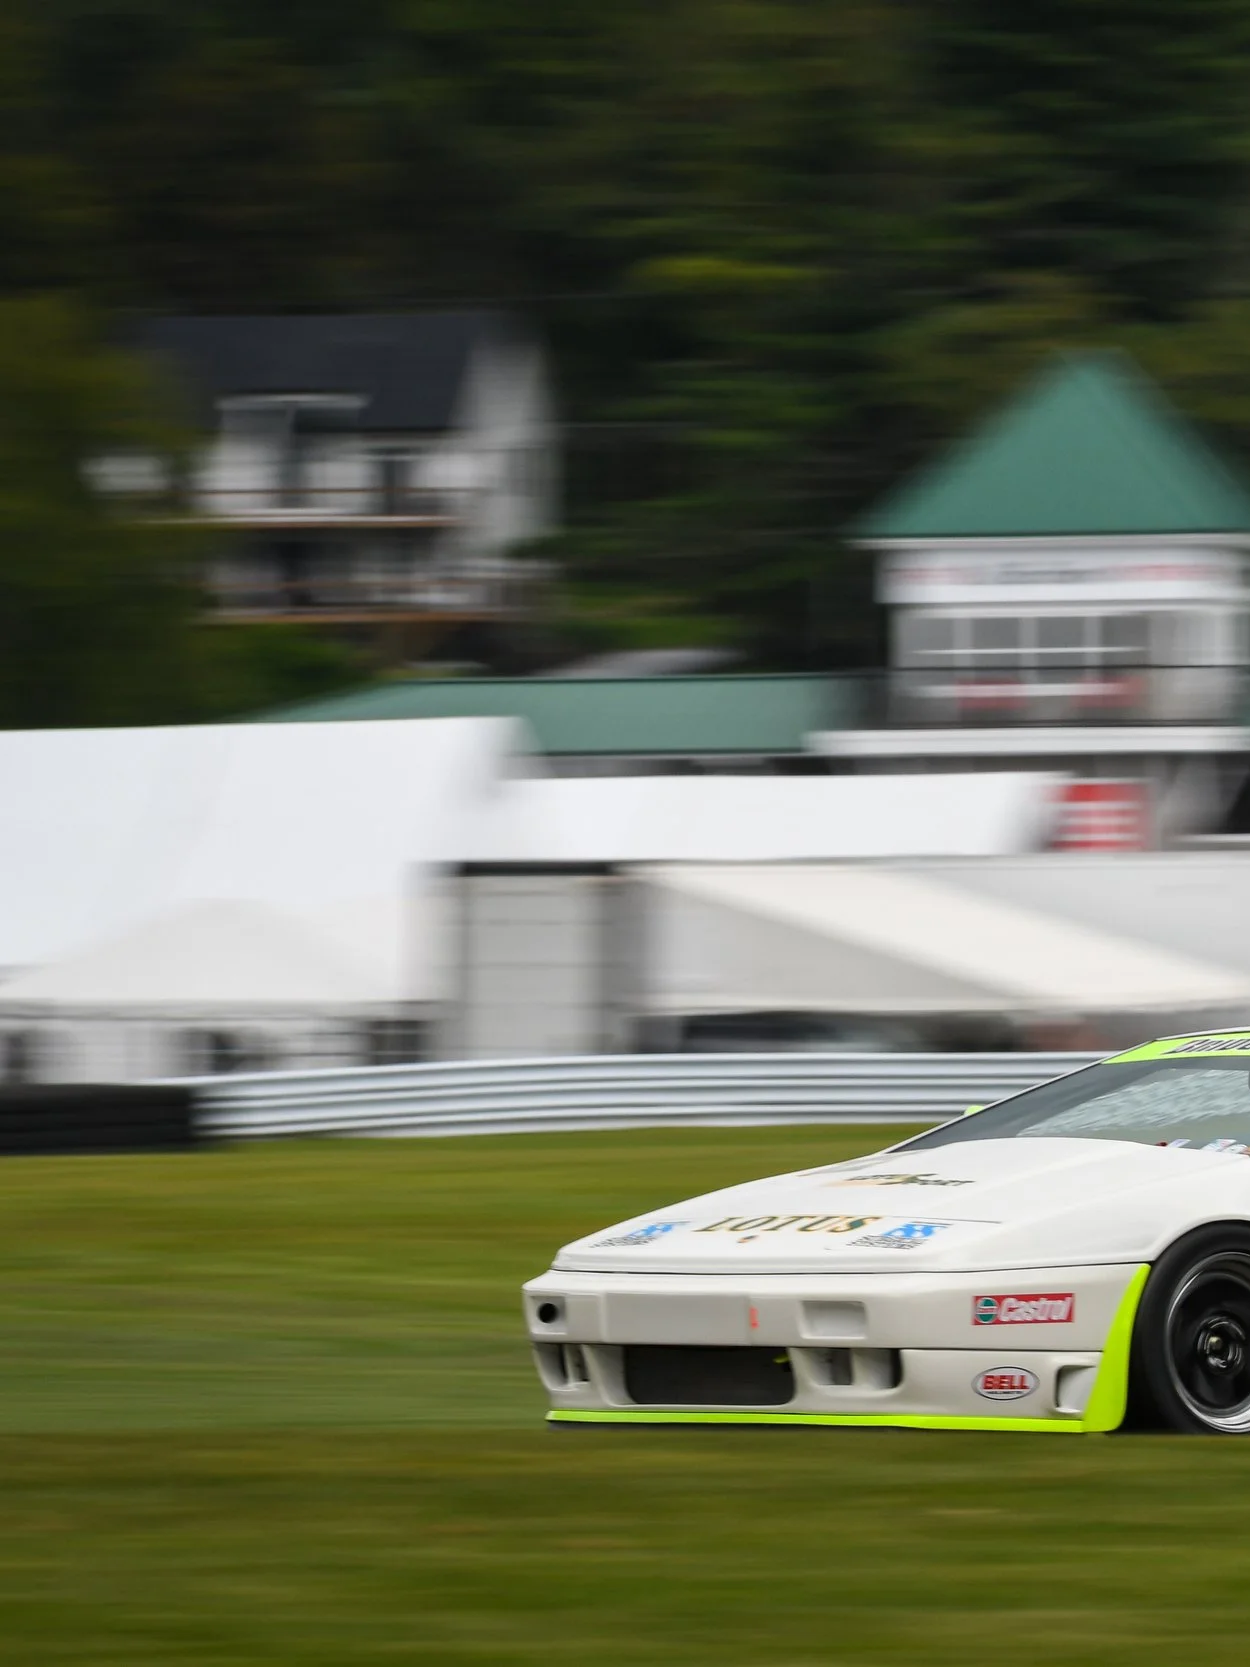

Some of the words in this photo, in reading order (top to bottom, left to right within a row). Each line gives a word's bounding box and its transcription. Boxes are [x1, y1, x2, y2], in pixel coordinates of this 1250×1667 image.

[693, 1215, 882, 1233] LOTUS
[998, 1297, 1073, 1322] Castrol
[982, 1374, 1030, 1390] BELL
